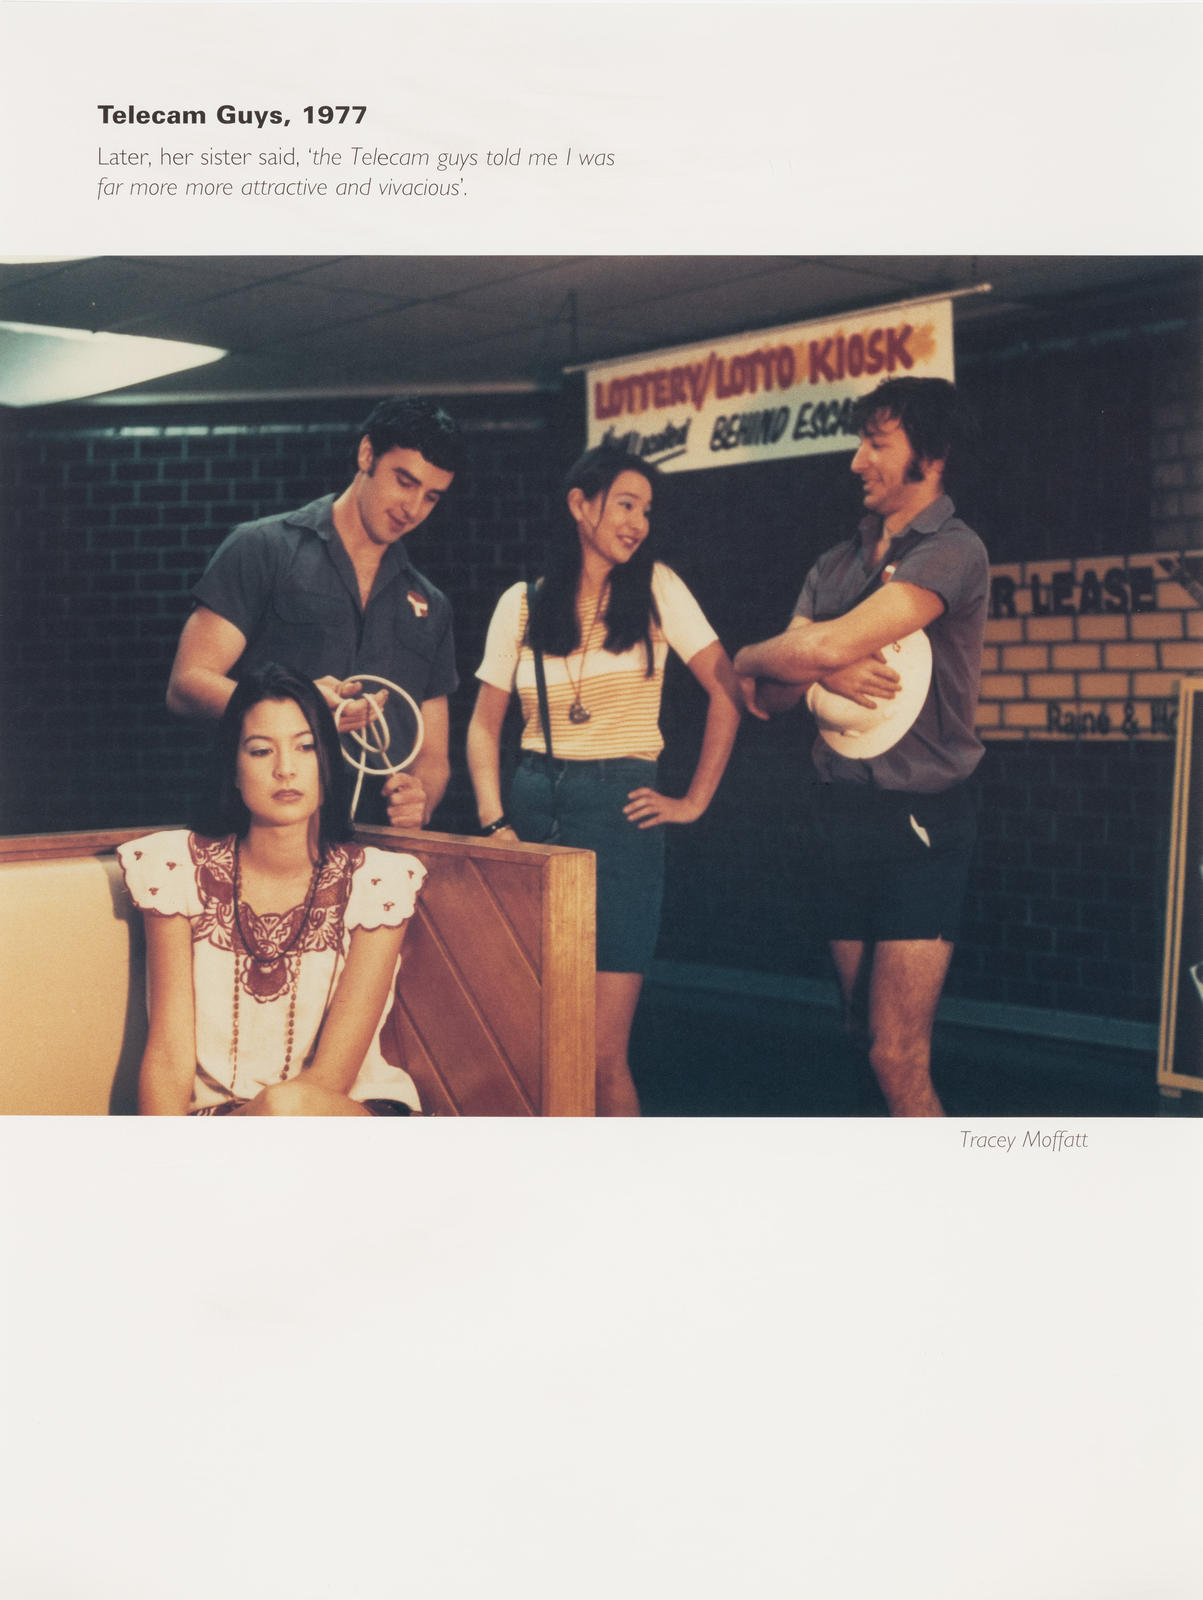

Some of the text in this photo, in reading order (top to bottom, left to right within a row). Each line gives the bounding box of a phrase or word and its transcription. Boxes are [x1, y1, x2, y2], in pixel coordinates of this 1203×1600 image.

[97, 105, 367, 129] Telecam Guys, 1977
[98, 147, 152, 168] Later,
[161, 147, 194, 166] her
[201, 147, 252, 166] sister
[259, 147, 300, 168] said,
[352, 147, 429, 167] Telecam
[437, 152, 478, 172] guys
[486, 147, 522, 166] told
[528, 152, 558, 166] me
[566, 147, 573, 166] I
[578, 152, 615, 166] was
[97, 177, 124, 201] far
[130, 182, 178, 196] more
[186, 182, 233, 196] more
[241, 177, 328, 196] attractive
[335, 177, 372, 196] and
[809, 323, 915, 386] KIOSK
[710, 405, 791, 451] BEHIND
[792, 397, 862, 440] ESCA
[1031, 566, 1157, 617] LEASE
[960, 1129, 1089, 1153] Tracey Moffatt
